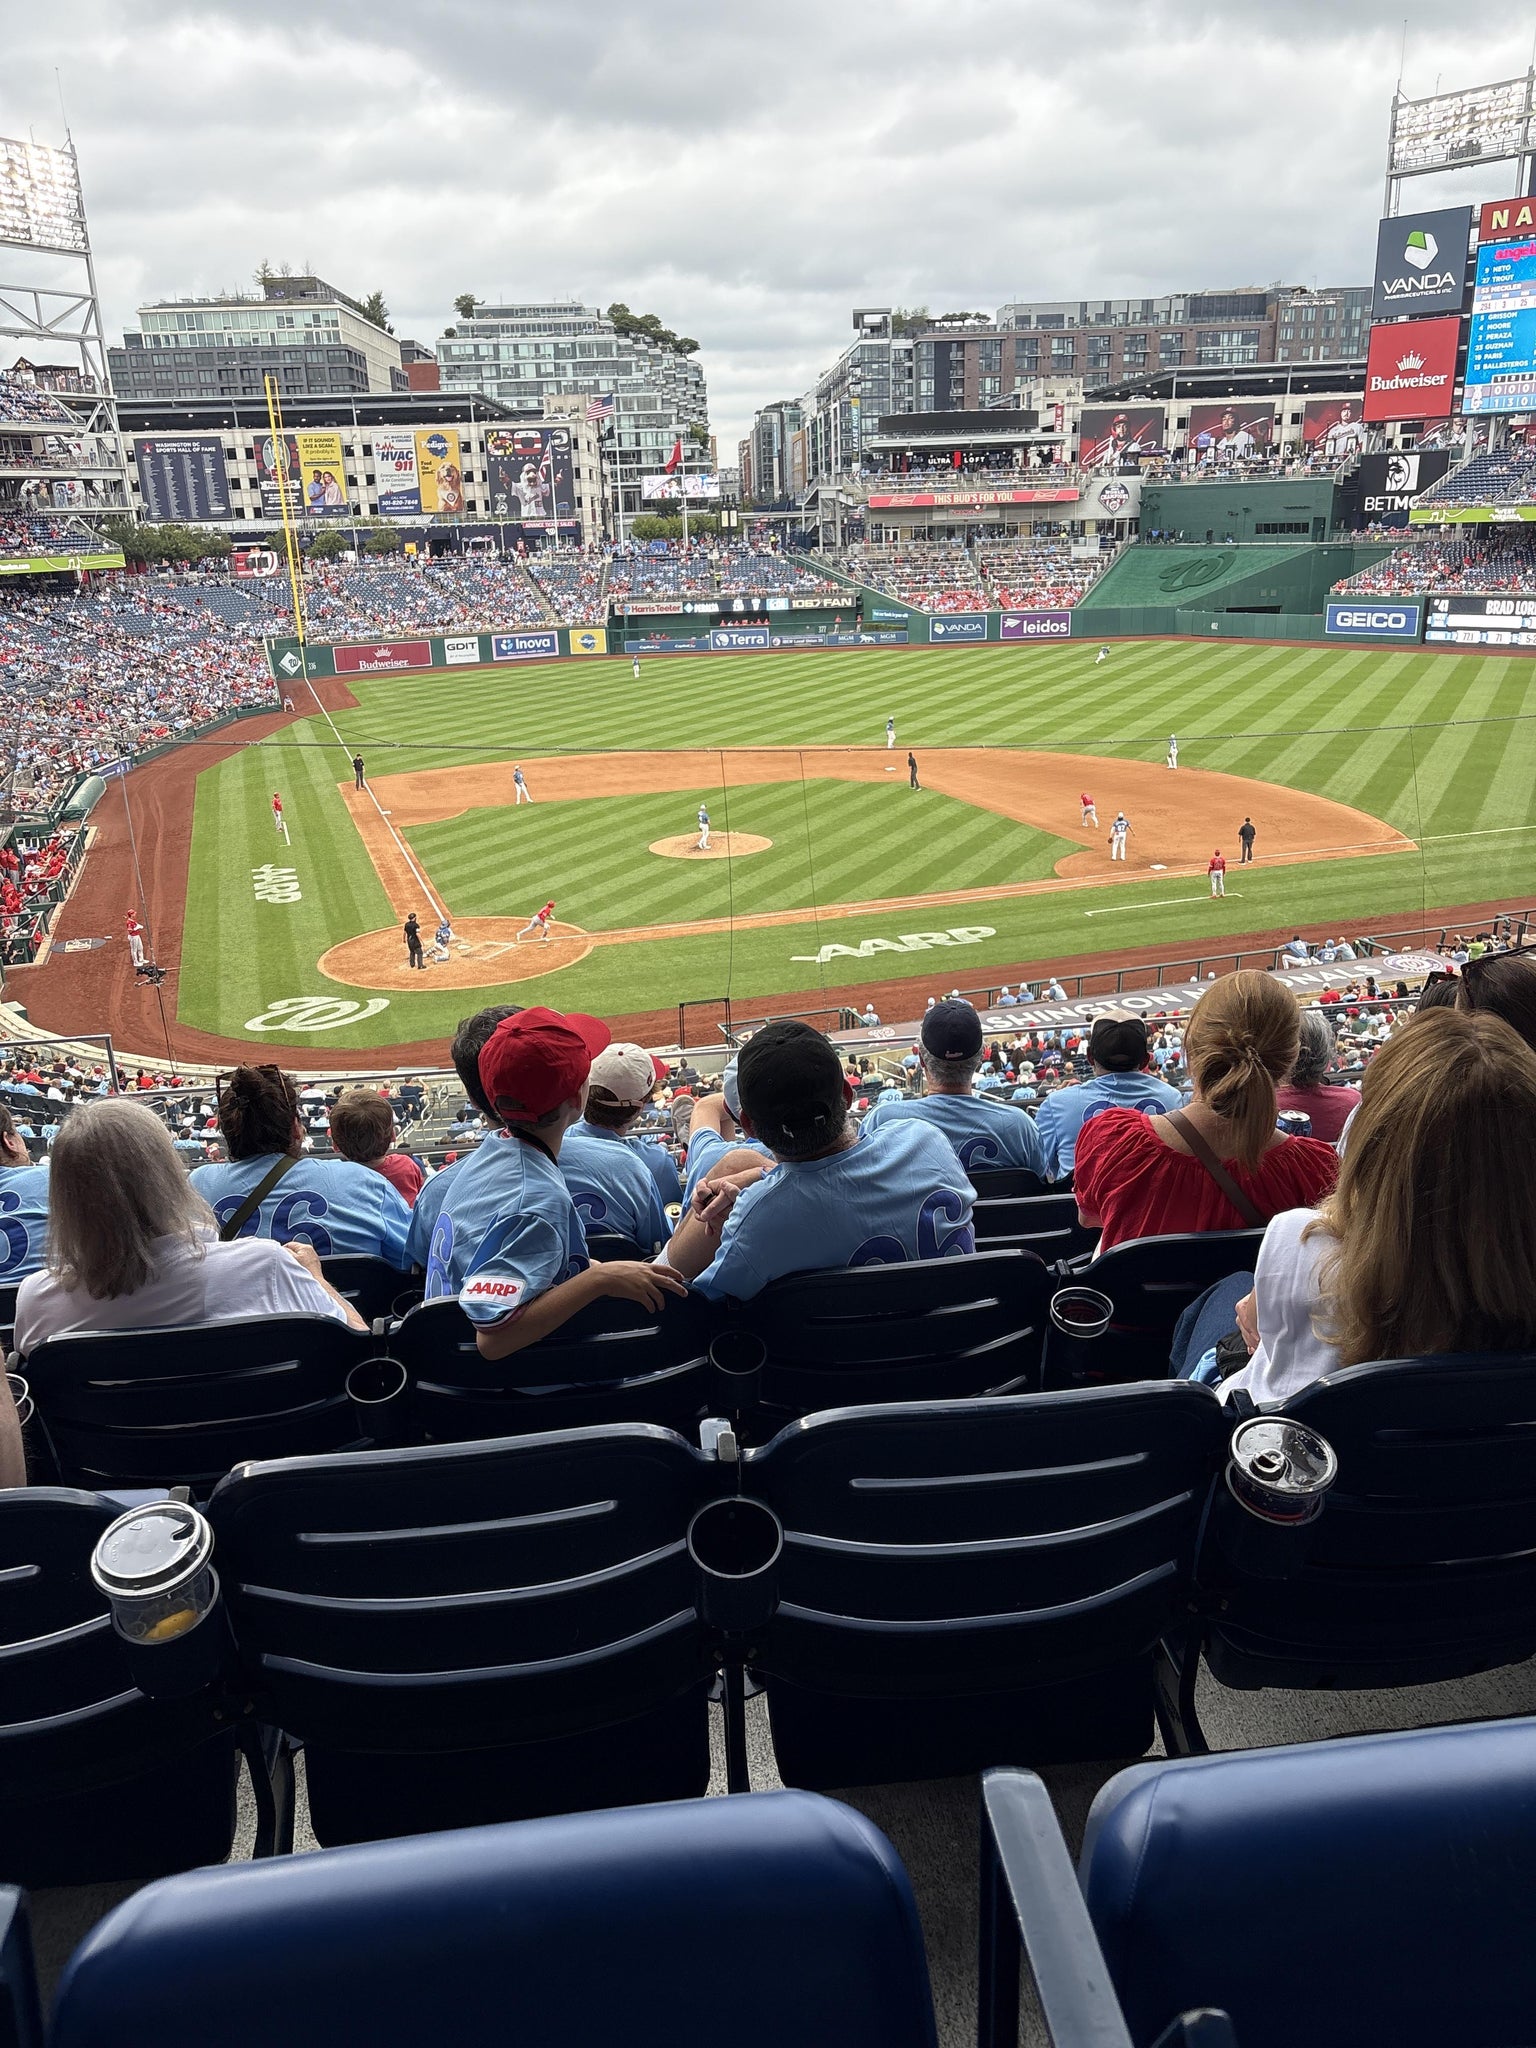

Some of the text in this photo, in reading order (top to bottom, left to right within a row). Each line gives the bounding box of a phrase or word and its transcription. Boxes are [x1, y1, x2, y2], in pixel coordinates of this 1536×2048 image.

[1491, 206, 1533, 230] NA
[1493, 264, 1511, 273] NETO
[1492, 274, 1514, 282] TROUT
[1382, 272, 1456, 295] VANDA
[1488, 312, 1517, 320] GRISSOM
[1487, 322, 1511, 330] MOORE
[1486, 332, 1512, 340] PERAZA
[1485, 342, 1513, 350] GUZMAN
[1483, 360, 1528, 370] BALLESTEROS
[1370, 373, 1448, 391] Budweiser
[1495, 386, 1502, 394] 0
[1508, 385, 1516, 393] 0
[1522, 384, 1530, 393] 0
[1507, 398, 1514, 406] 3
[1521, 397, 1528, 405] 0
[421, 441, 453, 449] Pedigree
[381, 451, 413, 461] HVAC
[928, 456, 985, 465] ULTRA LOFT
[395, 461, 413, 471] 911
[933, 492, 1015, 504] THIS BUD'S FOR YOU.
[1364, 494, 1420, 511] BETMG
[824, 598, 851, 607] FAN
[1485, 600, 1514, 615] BRAD
[1336, 611, 1407, 629] GEICO
[945, 623, 982, 631] VANDA
[1023, 620, 1068, 634] leidos
[515, 638, 551, 650] Inova
[730, 634, 764, 645] Terra
[447, 642, 477, 651] GDIT
[307, 662, 317, 671] 336
[359, 659, 409, 670] Budweiser
[251, 864, 302, 904] AARP
[789, 926, 997, 963] AARP
[1324, 952, 1334, 960] 23
[982, 992, 1183, 1030] SHINGTON
[467, 1282, 518, 1297] AARP
